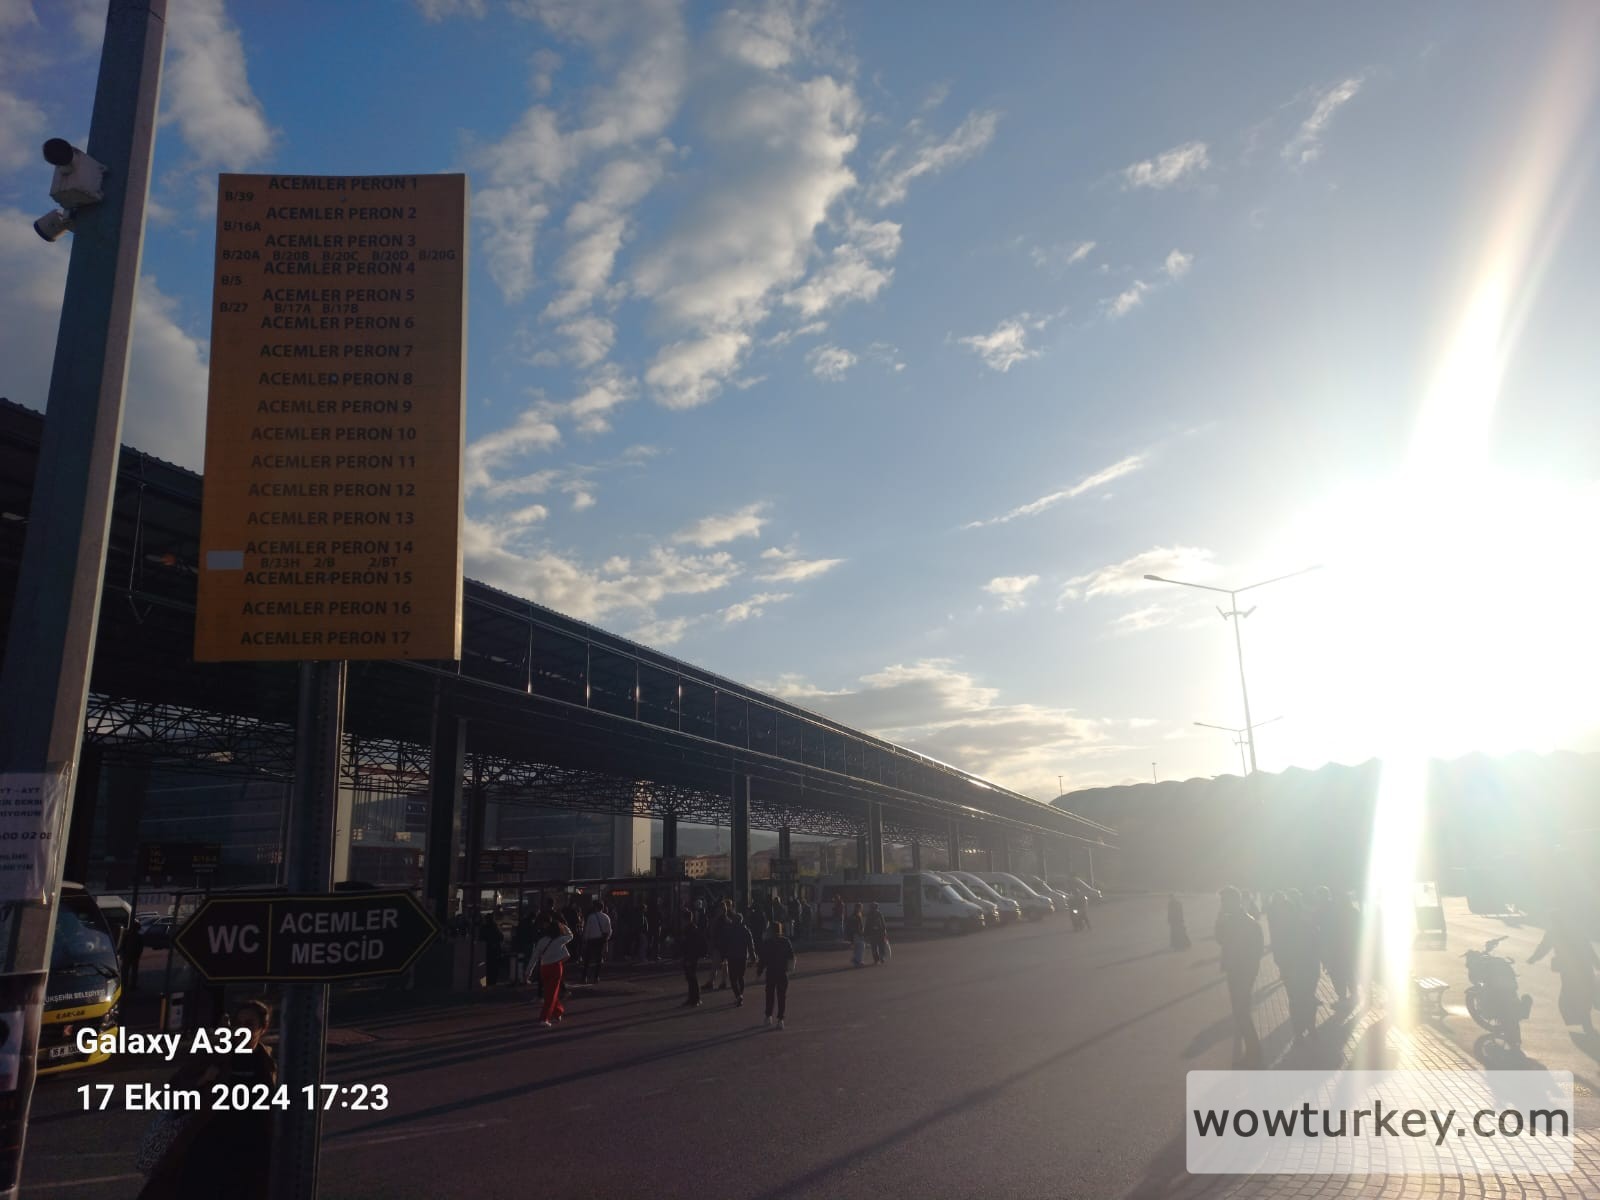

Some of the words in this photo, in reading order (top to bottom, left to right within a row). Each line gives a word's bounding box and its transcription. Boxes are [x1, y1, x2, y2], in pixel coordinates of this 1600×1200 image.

[269, 178, 346, 190] ACEMLER
[351, 178, 405, 190] PERON
[410, 178, 417, 190] 1
[266, 207, 344, 220] ACEMLER
[349, 207, 403, 219] PERON
[408, 207, 417, 219] 2
[265, 235, 343, 247] ACEMLER
[348, 235, 402, 247] PERON
[408, 235, 416, 247] 3
[264, 262, 341, 275] ACEMLER
[347, 262, 402, 275] PERON
[406, 263, 415, 274] 4
[263, 289, 341, 302] ACEMLER
[346, 289, 401, 302] PERON
[406, 289, 415, 301] 5
[261, 316, 340, 329] ACEMLER
[345, 316, 399, 329] PERON
[405, 316, 414, 329] 6
[260, 344, 339, 357] ACEMLER
[344, 344, 399, 357] PERON
[405, 345, 413, 357] 7
[343, 373, 398, 385] PERON
[403, 373, 413, 385] 8
[257, 400, 337, 413] ACEMLER
[342, 400, 398, 413] PERON
[403, 400, 413, 413] 9
[251, 428, 331, 441] ACEMLER
[336, 428, 393, 440] PERON
[398, 428, 416, 440] 10
[251, 455, 331, 469] ACEMLER
[336, 455, 393, 468] PERON
[399, 456, 416, 468] 11
[248, 484, 329, 497] ACEMLER
[334, 484, 391, 497] PERON
[397, 484, 415, 497] 12
[247, 512, 328, 525] ACEMLER
[333, 512, 390, 525] PERON
[397, 512, 415, 525] 13
[246, 541, 327, 554] ACEMLER
[332, 541, 389, 554] PERON
[395, 541, 413, 554] 14
[244, 571, 325, 585] ACEMLER
[331, 571, 389, 585] PERON
[395, 572, 413, 585] 15
[242, 601, 324, 615] ACEMLER
[329, 601, 387, 615] PERON
[393, 602, 411, 615] 16
[240, 632, 323, 645] ACEMLER
[328, 632, 386, 645] PERON
[392, 632, 410, 645] 17
[279, 907, 399, 934] ACEMLER
[207, 924, 260, 955] WC
[291, 935, 384, 965] MESCİD
